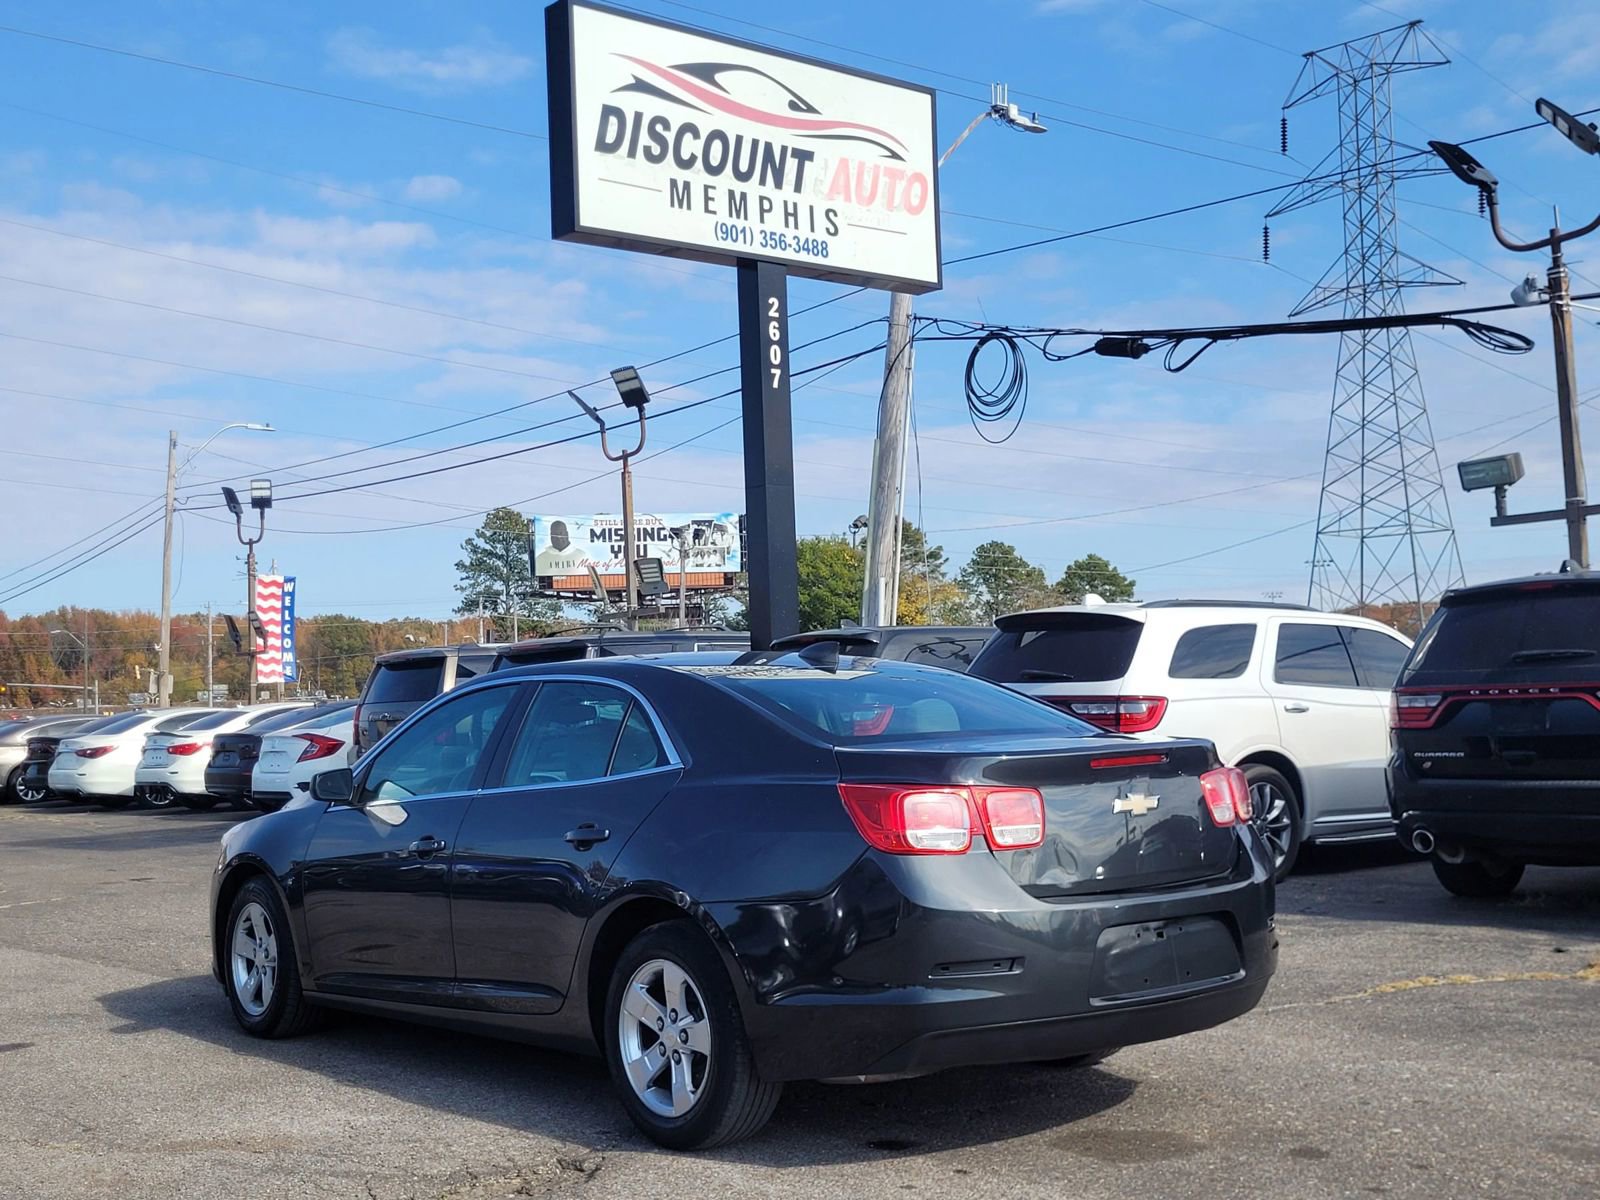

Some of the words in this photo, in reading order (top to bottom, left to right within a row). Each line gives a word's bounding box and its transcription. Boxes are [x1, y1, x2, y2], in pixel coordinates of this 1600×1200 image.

[594, 104, 815, 194] DISCOUNT
[826, 157, 929, 216] AUTO
[669, 178, 839, 237] MEMPHIS
[714, 221, 754, 248] (901)
[759, 229, 829, 259] 356-3488
[768, 297, 781, 389] 2607
[590, 527, 667, 542] MISING
[610, 544, 648, 559] YU
[283, 582, 294, 676] WELCOME
